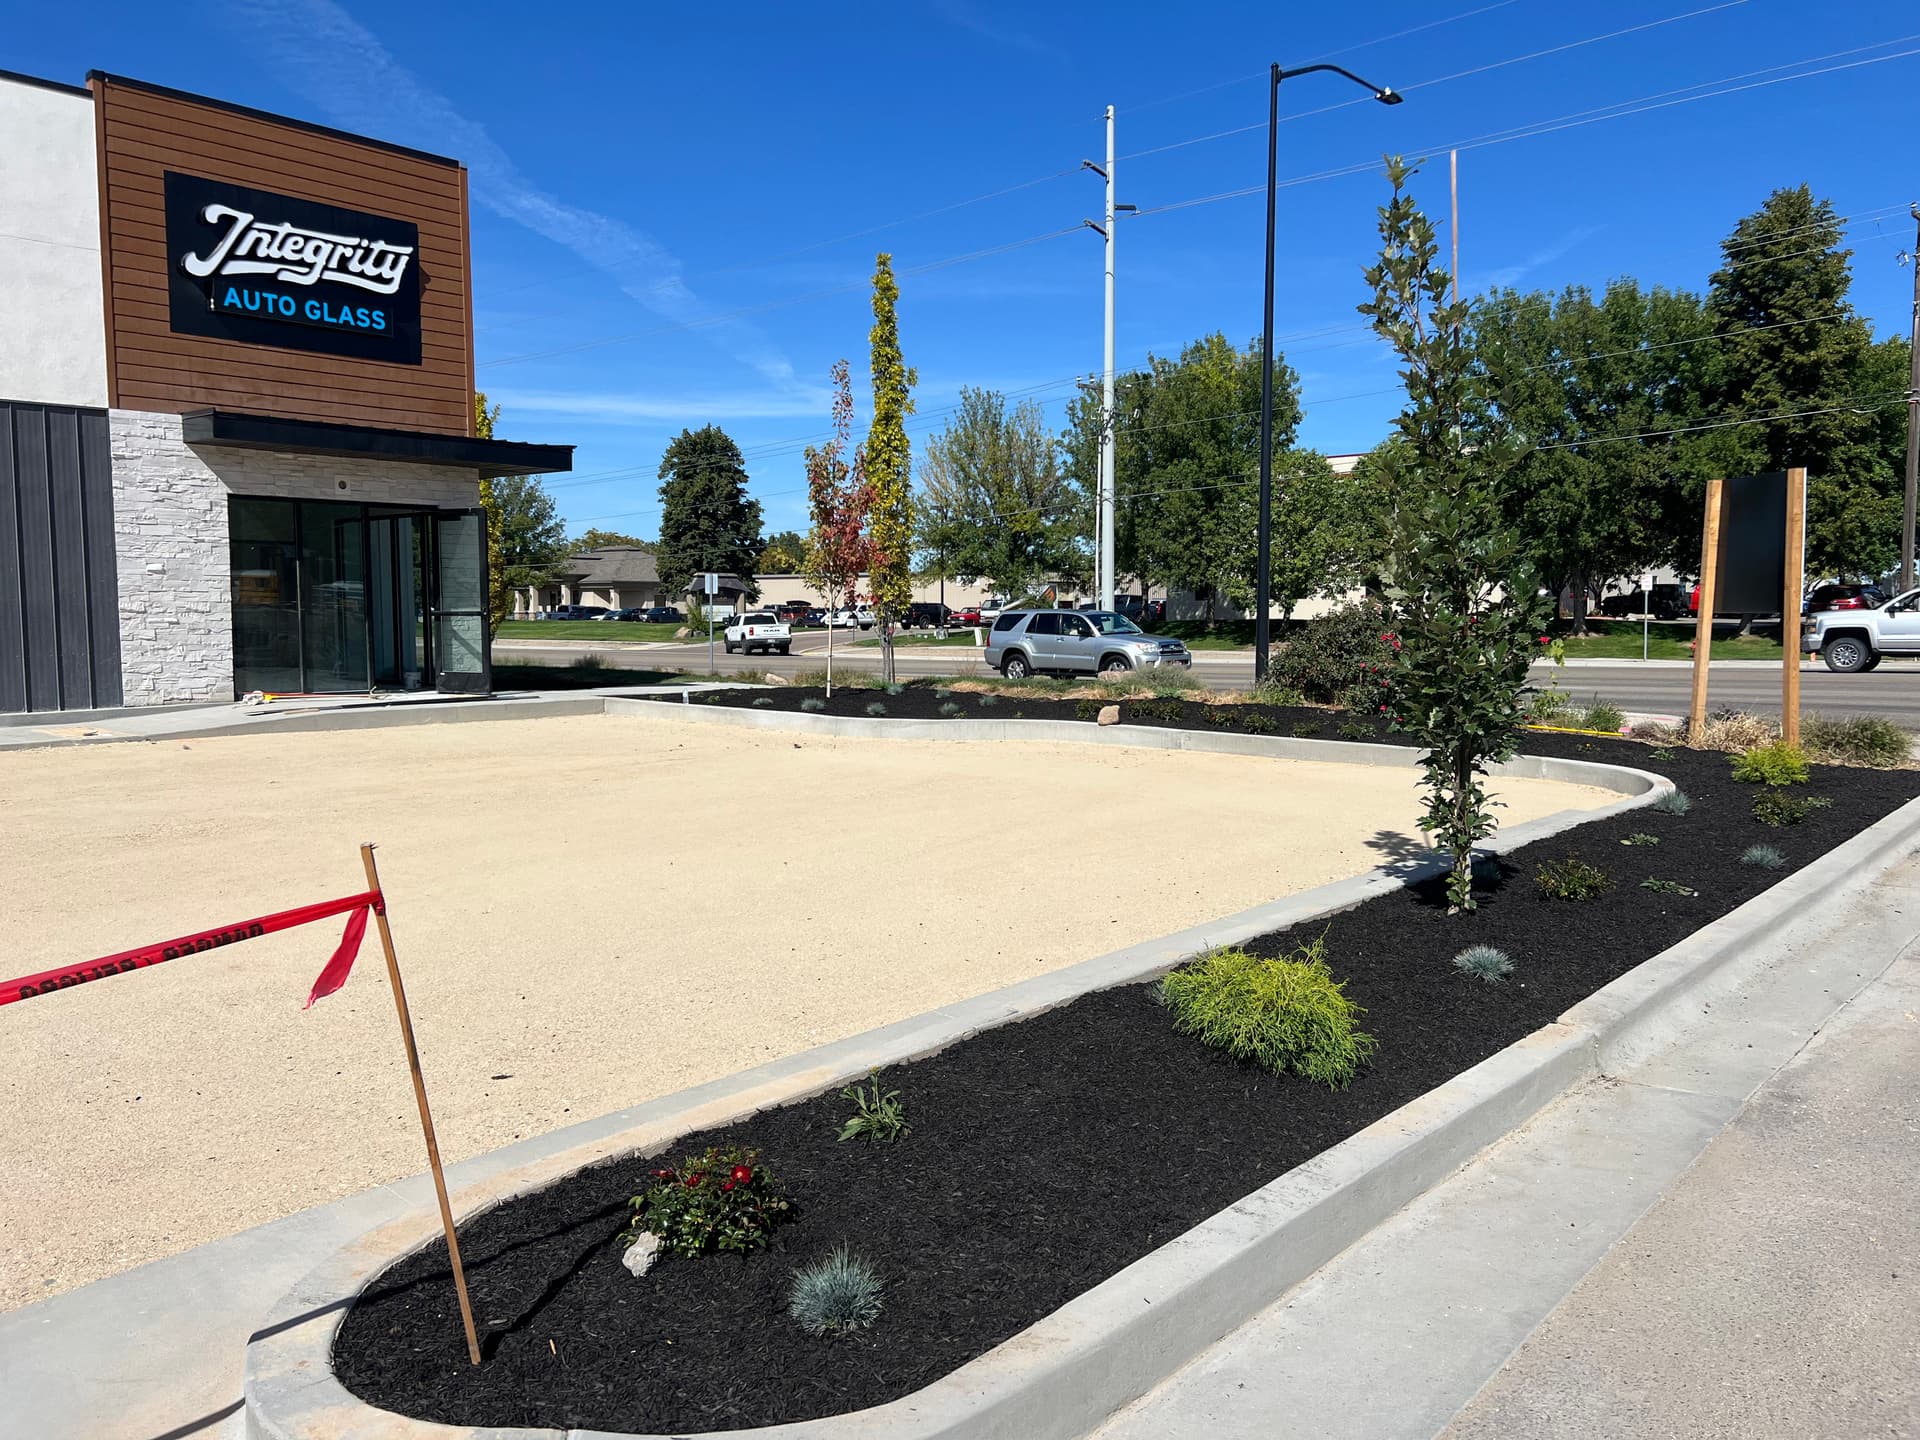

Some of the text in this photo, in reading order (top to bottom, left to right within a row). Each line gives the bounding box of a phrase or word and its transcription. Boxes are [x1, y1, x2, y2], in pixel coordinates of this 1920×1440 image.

[184, 204, 413, 294] Integrity
[223, 287, 386, 330] AUTO GLASS
